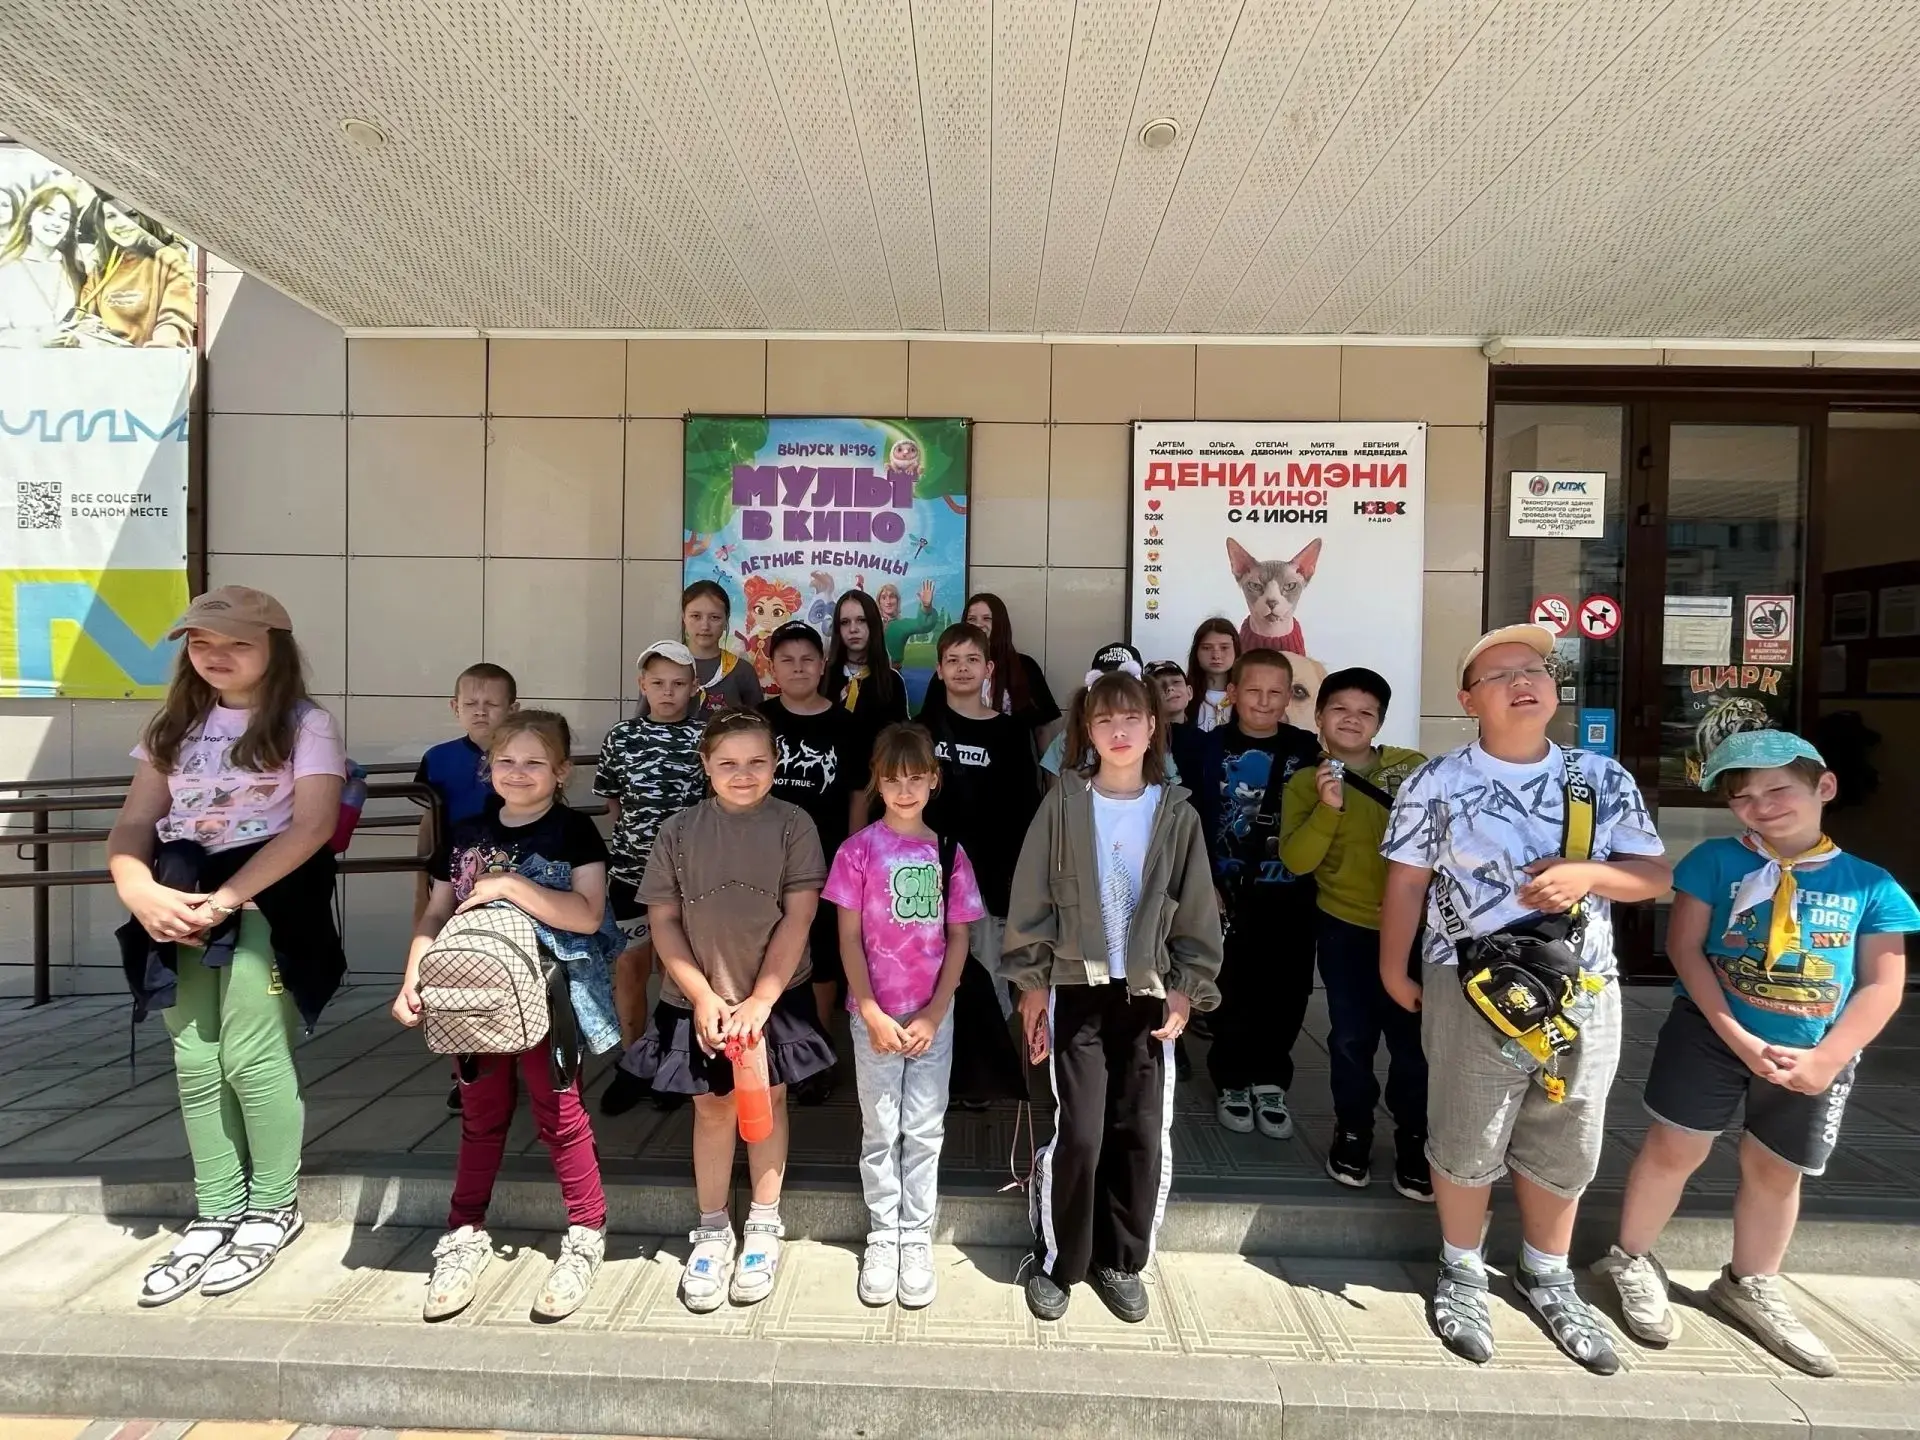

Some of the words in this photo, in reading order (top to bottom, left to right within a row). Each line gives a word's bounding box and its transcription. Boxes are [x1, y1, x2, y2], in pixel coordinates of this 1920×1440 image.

[778, 443, 834, 457] ВЫПУСК
[839, 443, 877, 457] №196
[1354, 449, 1408, 457] МЕДВЕДЕВА
[1144, 462, 1256, 491] ДЕНИ
[1286, 462, 1407, 488] МЭНИ
[731, 464, 913, 509] МУЛЬТ
[71, 493, 92, 503] ВСЕ
[96, 493, 152, 505] СОЦСЕТИ
[1228, 490, 1245, 506] В
[1250, 490, 1328, 506] КИНО!
[71, 507, 78, 517] В
[81, 507, 126, 518] ОДНОМ
[130, 507, 169, 517] МЕСТЕ
[1227, 508, 1243, 524] С
[1245, 509, 1259, 523] 4
[1264, 509, 1328, 524] ИЮНЯ
[742, 509, 774, 542] В
[783, 509, 906, 543] КИНО
[741, 550, 805, 576] ЛЕТНИЕ
[810, 550, 909, 577] НЕБЫЛИЦЫ
[1690, 664, 1782, 696] ЦИРК
[1693, 701, 1706, 710] 0+
[895, 895, 941, 919] OUT
